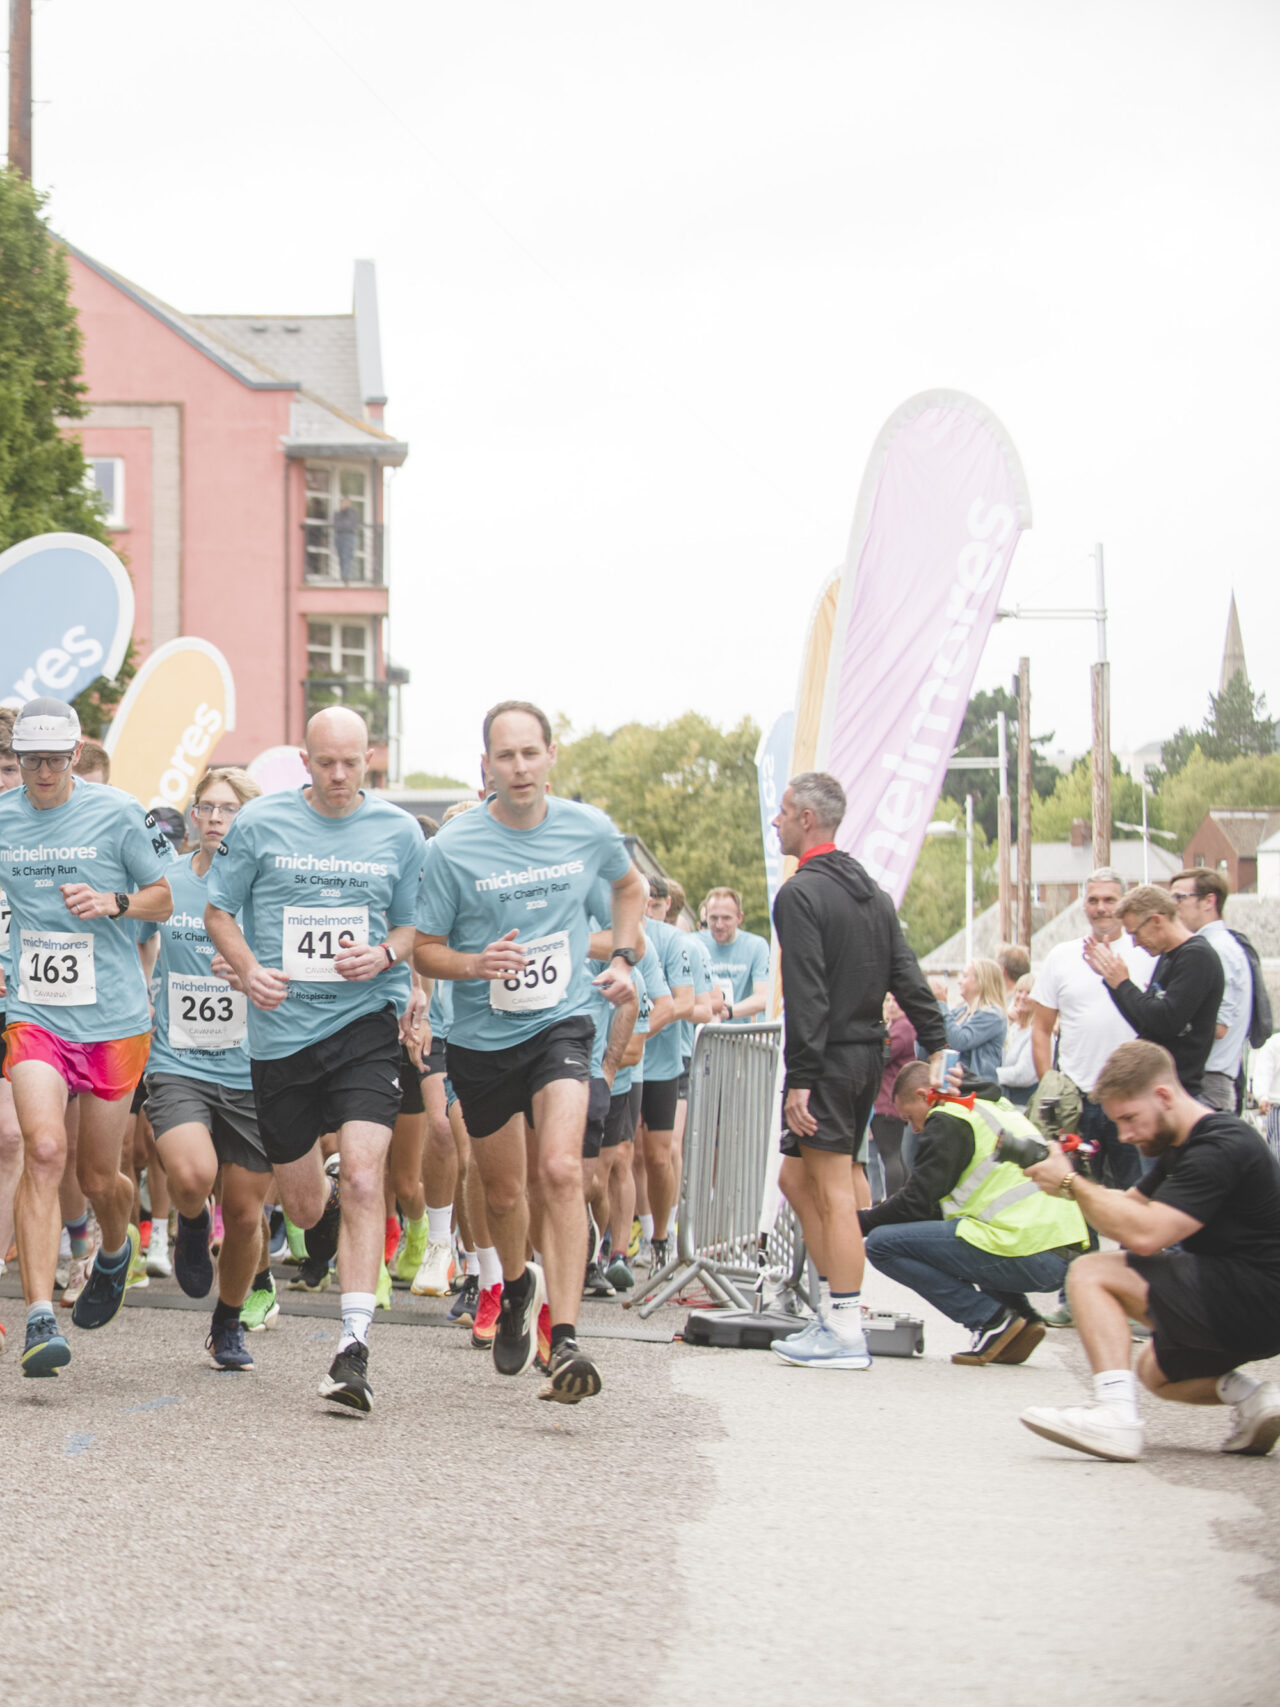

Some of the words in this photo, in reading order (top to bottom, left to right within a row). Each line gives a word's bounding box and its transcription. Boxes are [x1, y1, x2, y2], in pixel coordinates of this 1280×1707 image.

[0, 845, 98, 863] michelmores
[12, 867, 21, 877] 5k
[23, 866, 56, 877] Charity
[58, 865, 77, 875] Run
[275, 852, 388, 877] michelmores
[295, 874, 307, 884] 5k
[310, 875, 346, 888] Charity
[349, 878, 368, 888] Run
[476, 860, 584, 892] michelmores
[499, 892, 512, 903] 5k
[514, 887, 549, 901] Charity
[551, 883, 569, 893] Run
[288, 914, 364, 926] michelmores
[23, 936, 88, 950] michelmores
[172, 931, 183, 940] 5k
[195, 945, 215, 954] 2026
[29, 953, 79, 984] 163
[181, 996, 234, 1022] 263
